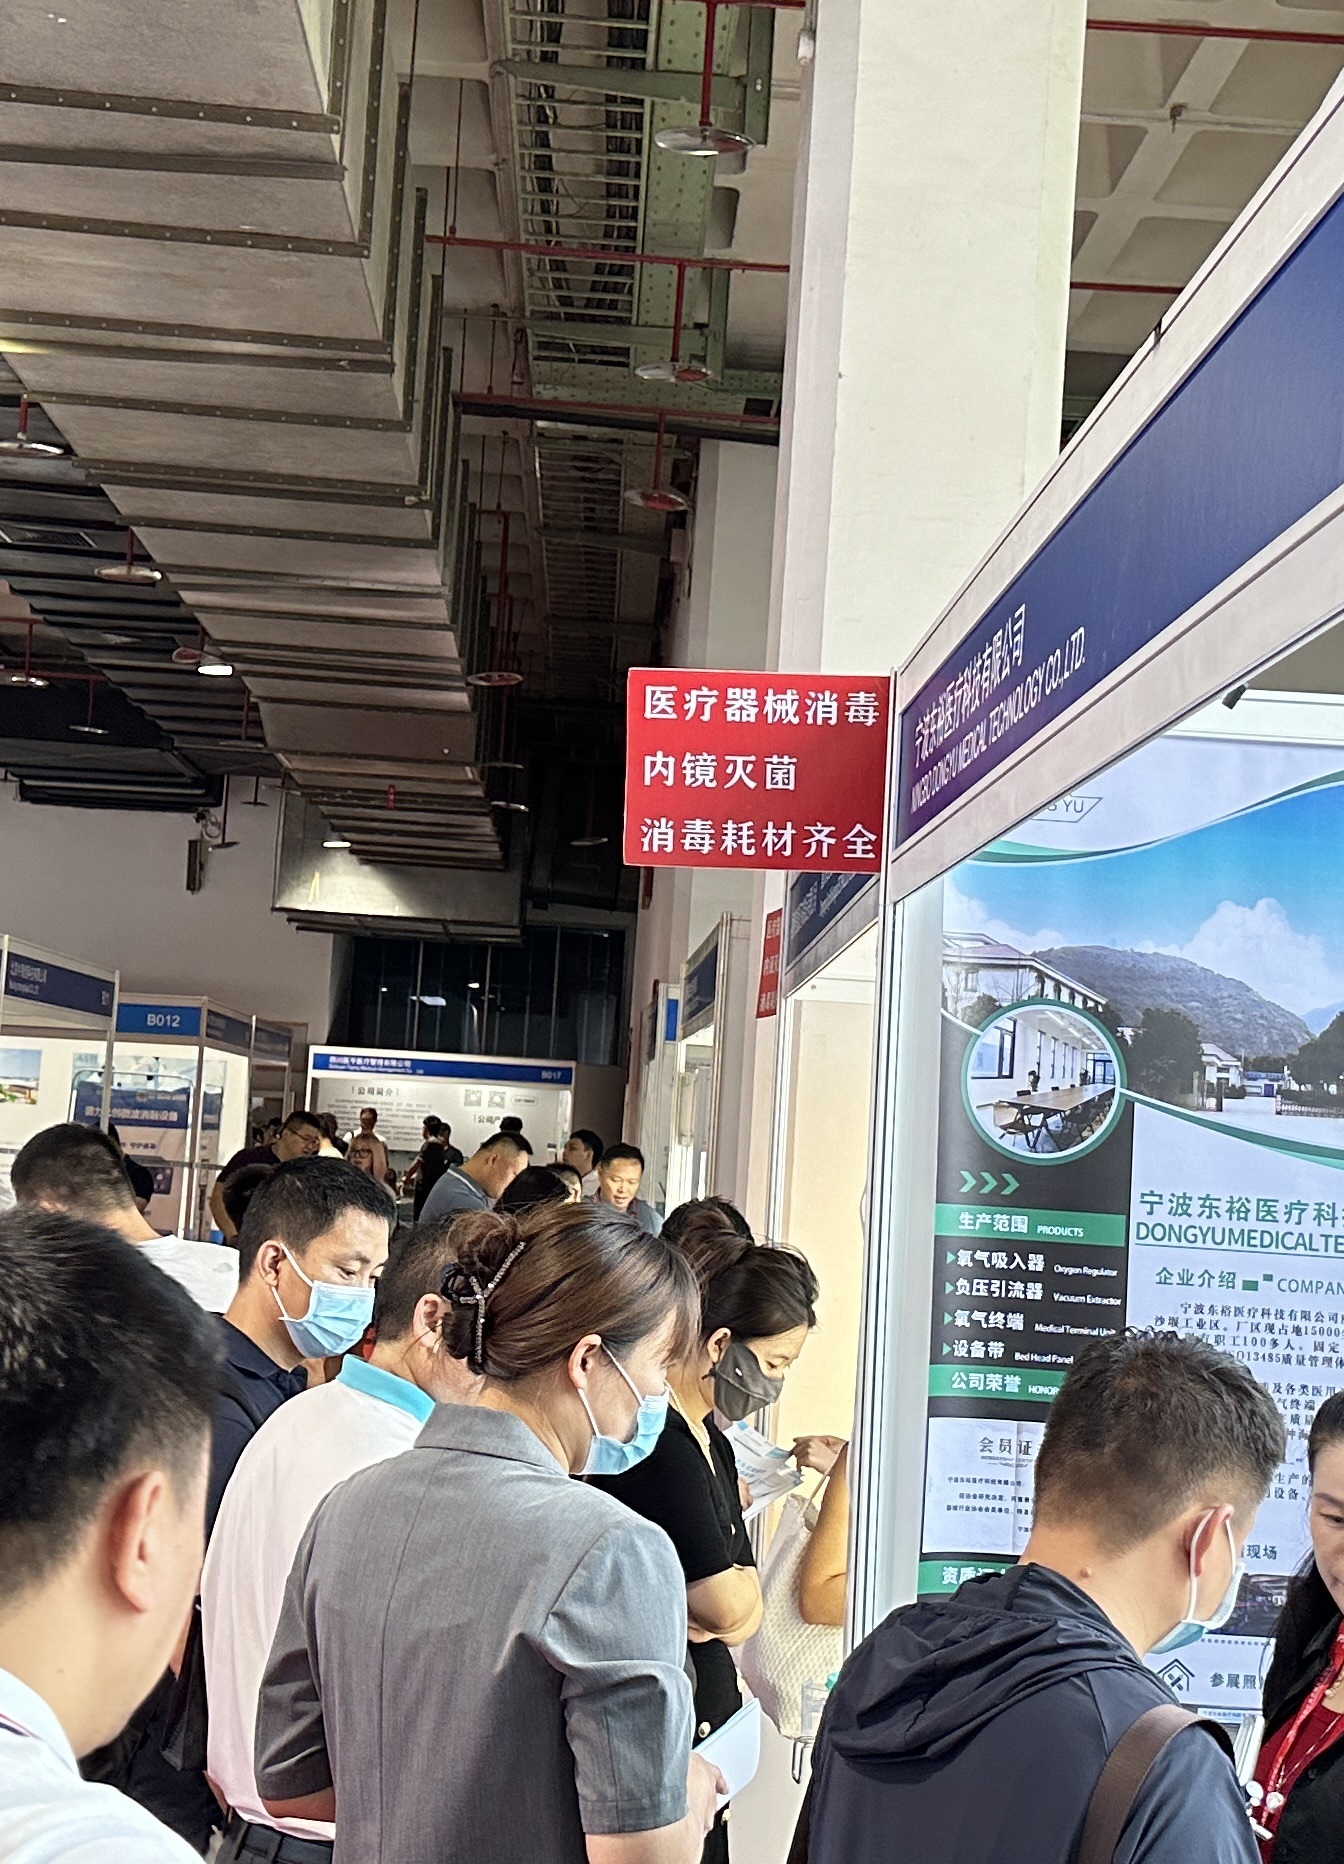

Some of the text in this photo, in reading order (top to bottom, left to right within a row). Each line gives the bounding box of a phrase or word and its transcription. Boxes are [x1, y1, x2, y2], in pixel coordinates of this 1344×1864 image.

[643, 684, 881, 726] 医疗器械消毒
[642, 751, 799, 791] 内镜灭菌
[640, 817, 878, 860] 消毒耗材齐全
[146, 1013, 181, 1027] B012
[958, 1211, 1084, 1238] 生产范围 PRODUCTS
[956, 1249, 1118, 1278] 氧气吸入器 Oxygen Regulator
[1155, 1266, 1237, 1290] 企业介绍
[955, 1278, 1122, 1306] 负压引流器 Vacuum Extractor
[954, 1310, 1024, 1331] 氧气终端
[1034, 1323, 1065, 1335] Medical
[1066, 1325, 1099, 1337] Terminal
[953, 1339, 1074, 1365] 设备带 Bed Head Panel
[951, 1371, 1022, 1394] 公司荣誉
